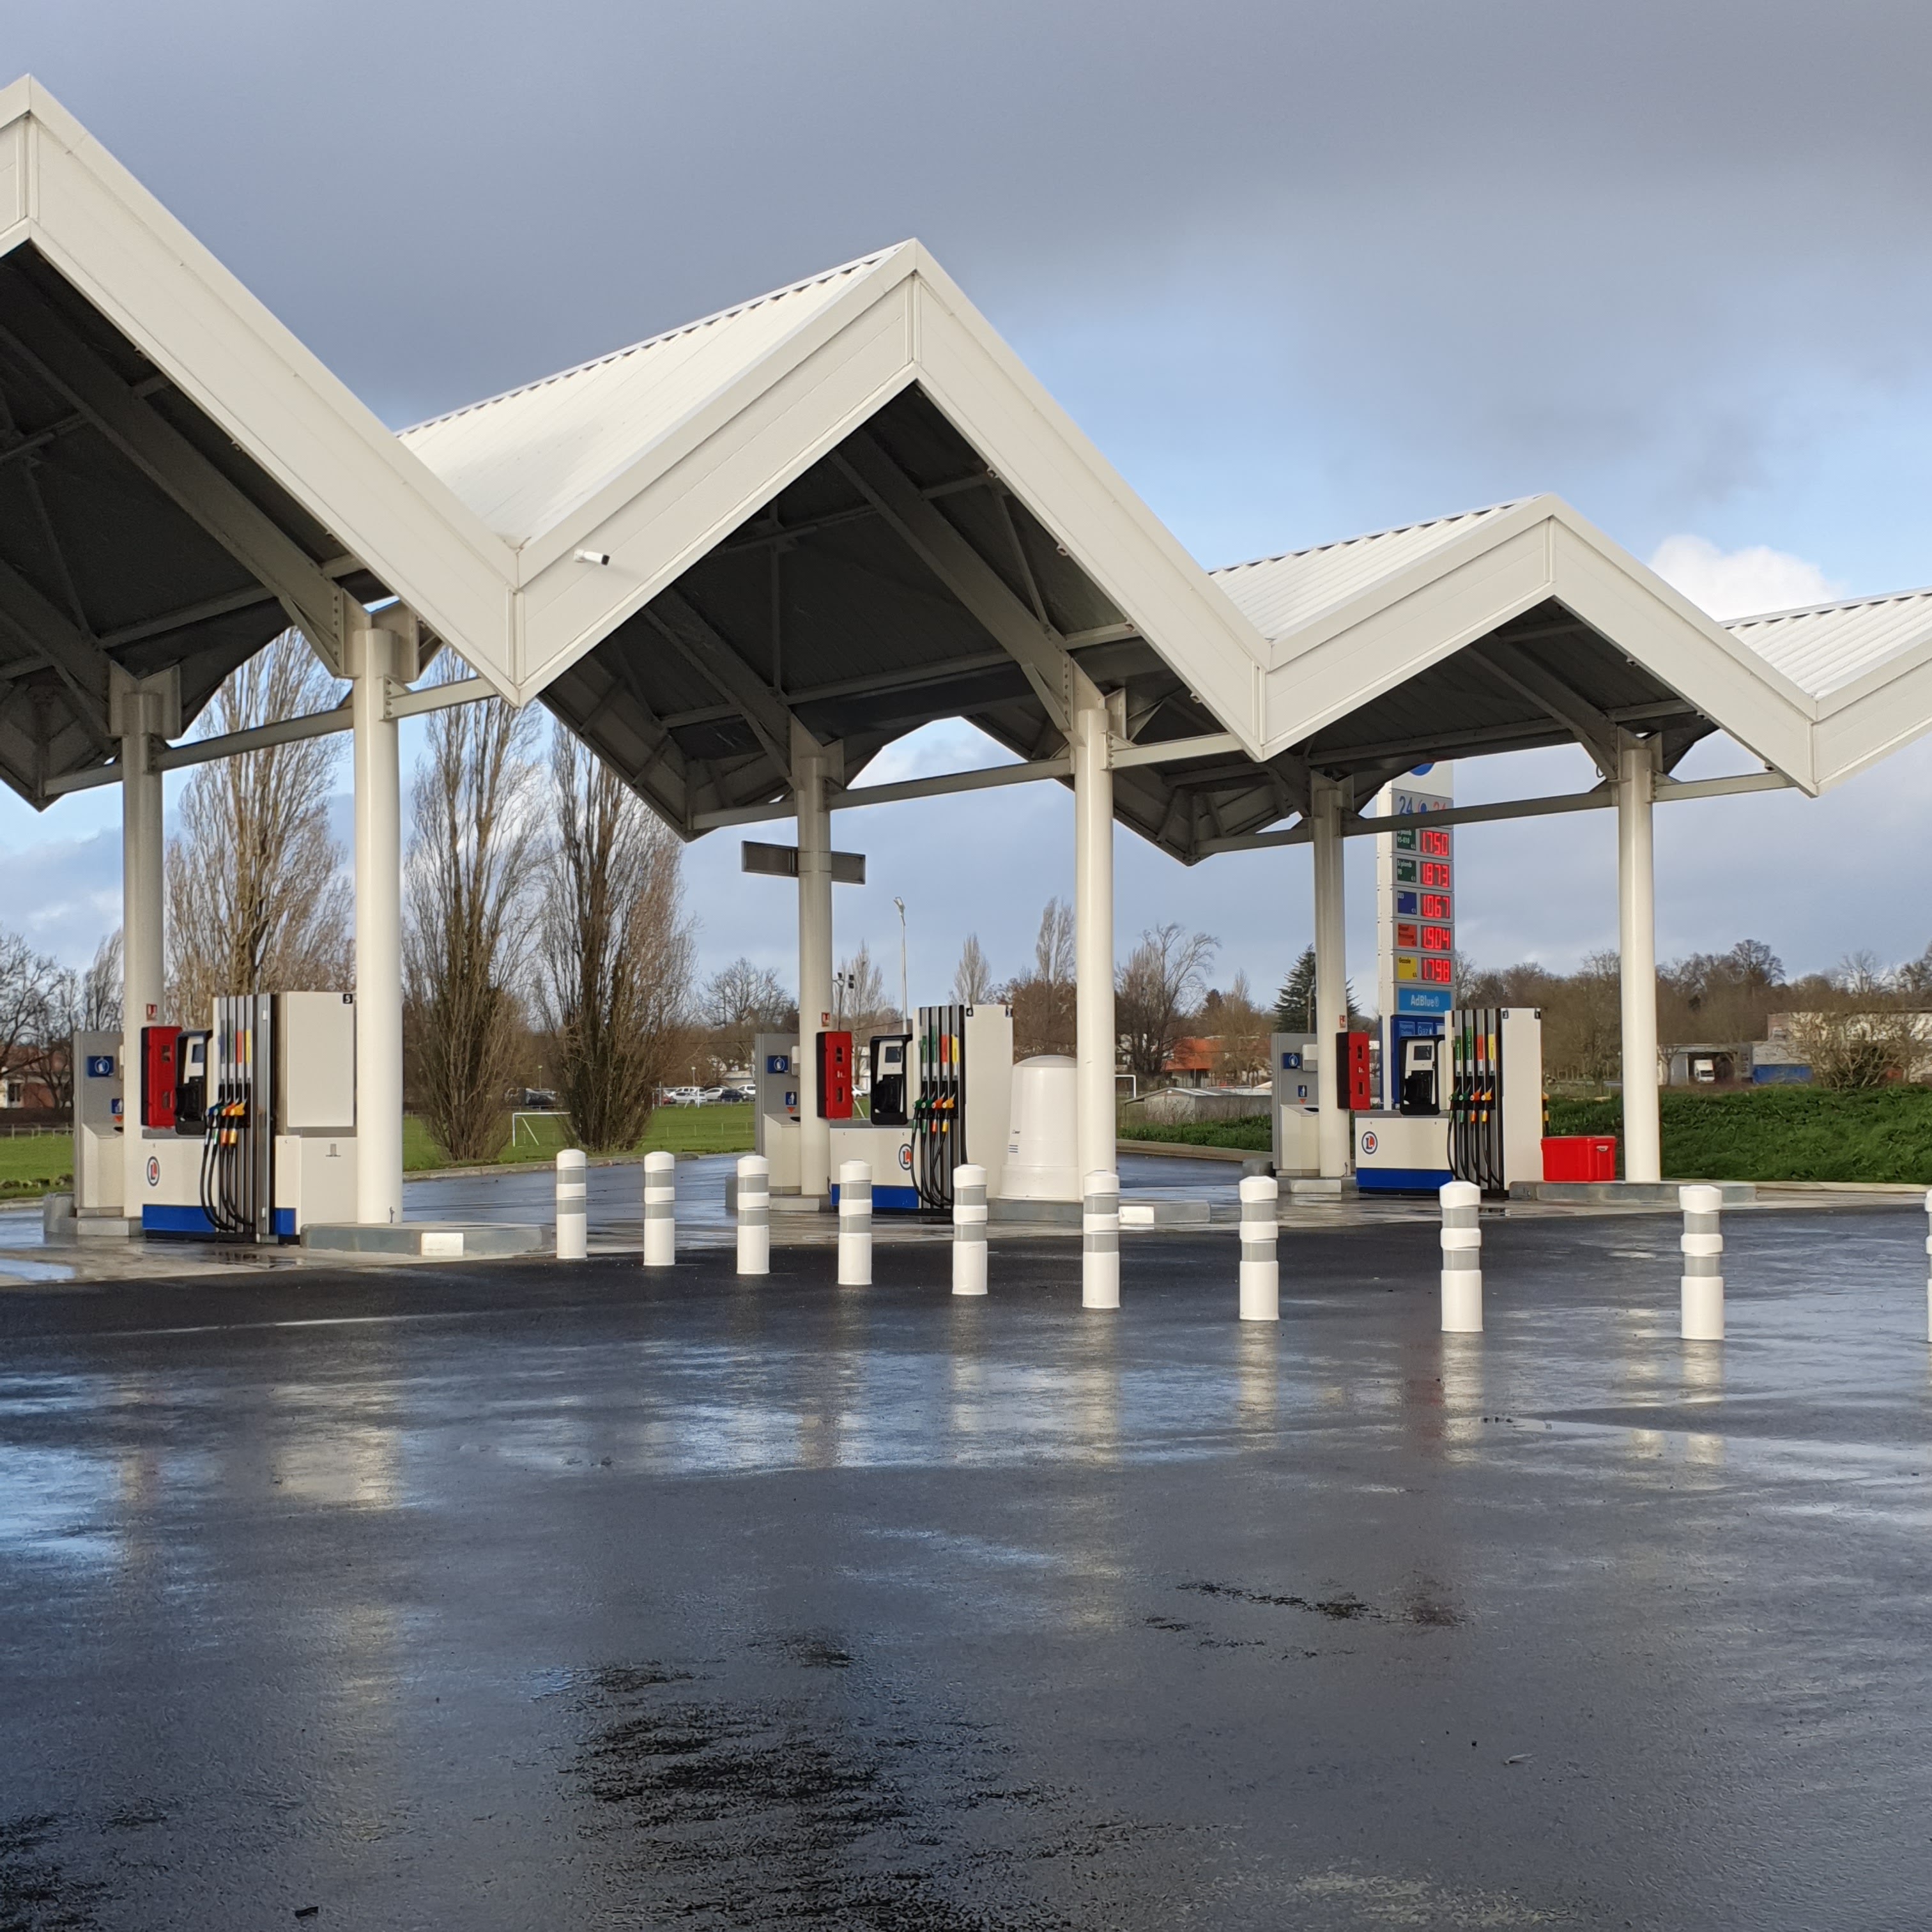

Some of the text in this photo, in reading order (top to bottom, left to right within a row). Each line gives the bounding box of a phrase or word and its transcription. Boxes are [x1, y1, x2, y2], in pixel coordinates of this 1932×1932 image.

[1399, 795, 1413, 815] 24
[345, 995, 351, 1003] 5
[1418, 1025, 1428, 1035] Gaz
